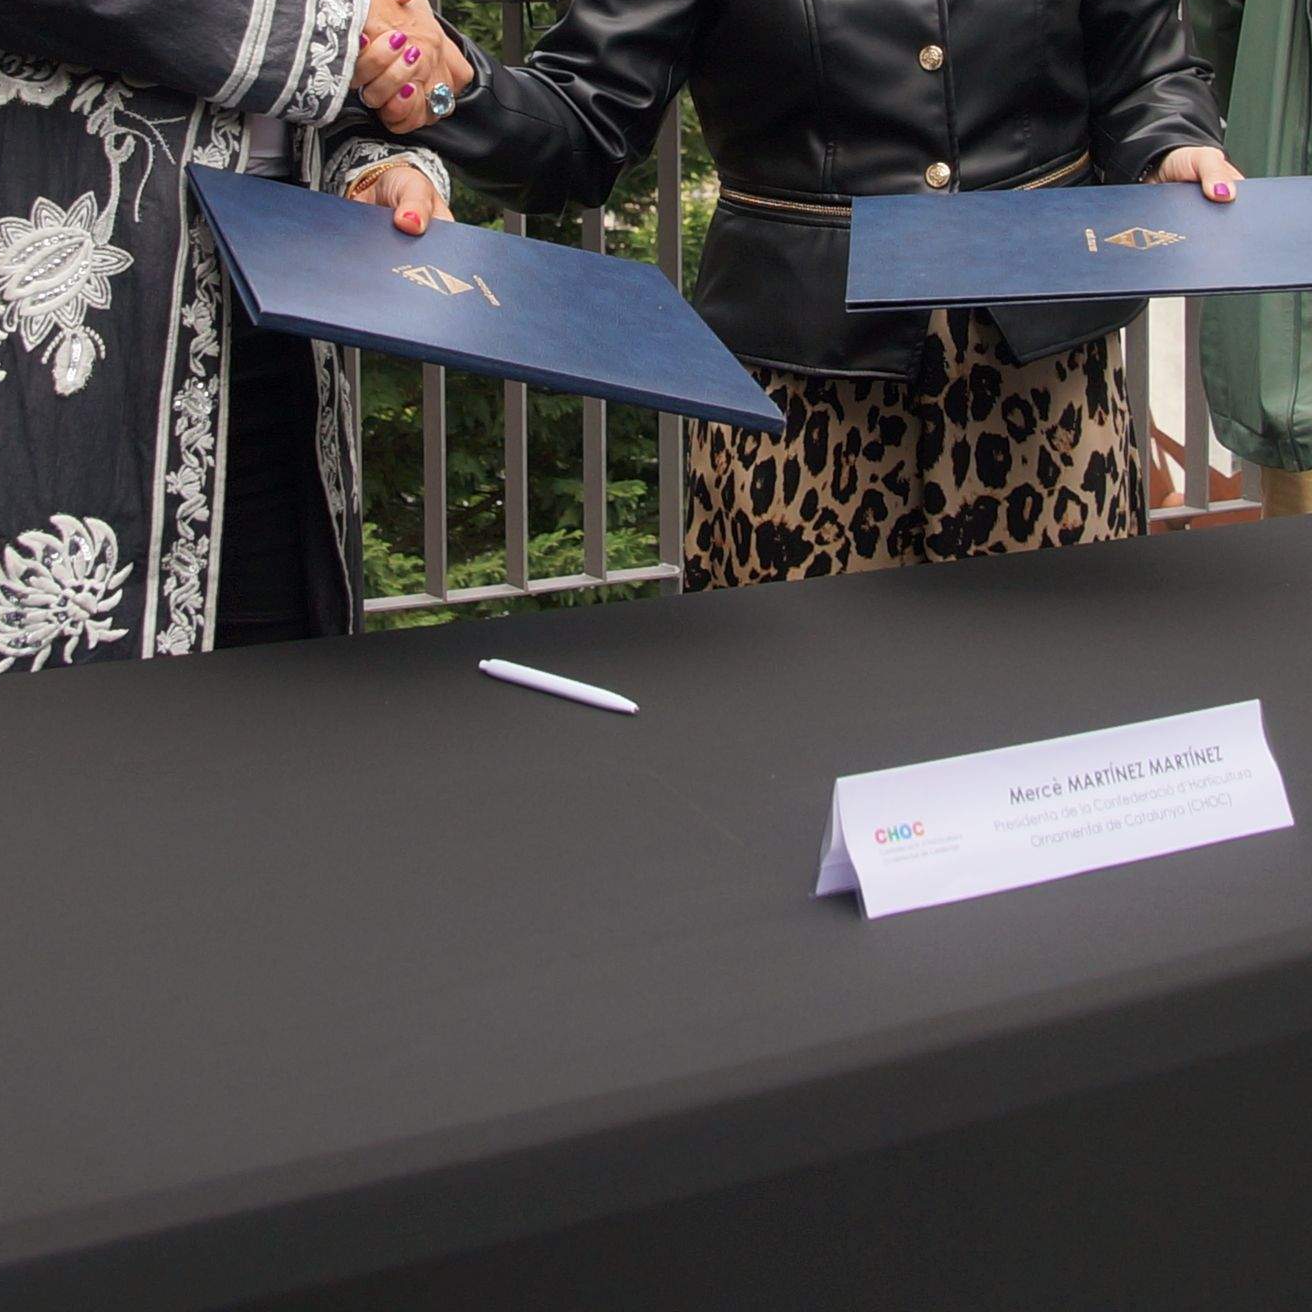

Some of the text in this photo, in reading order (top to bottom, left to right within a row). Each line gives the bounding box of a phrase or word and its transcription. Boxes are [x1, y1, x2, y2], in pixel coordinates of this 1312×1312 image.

[1009, 745, 1223, 806] Mercè MARTÍNEZ MARTÍNEZ
[1187, 791, 1233, 816] (CHOC)
[874, 820, 926, 844] CHOC
